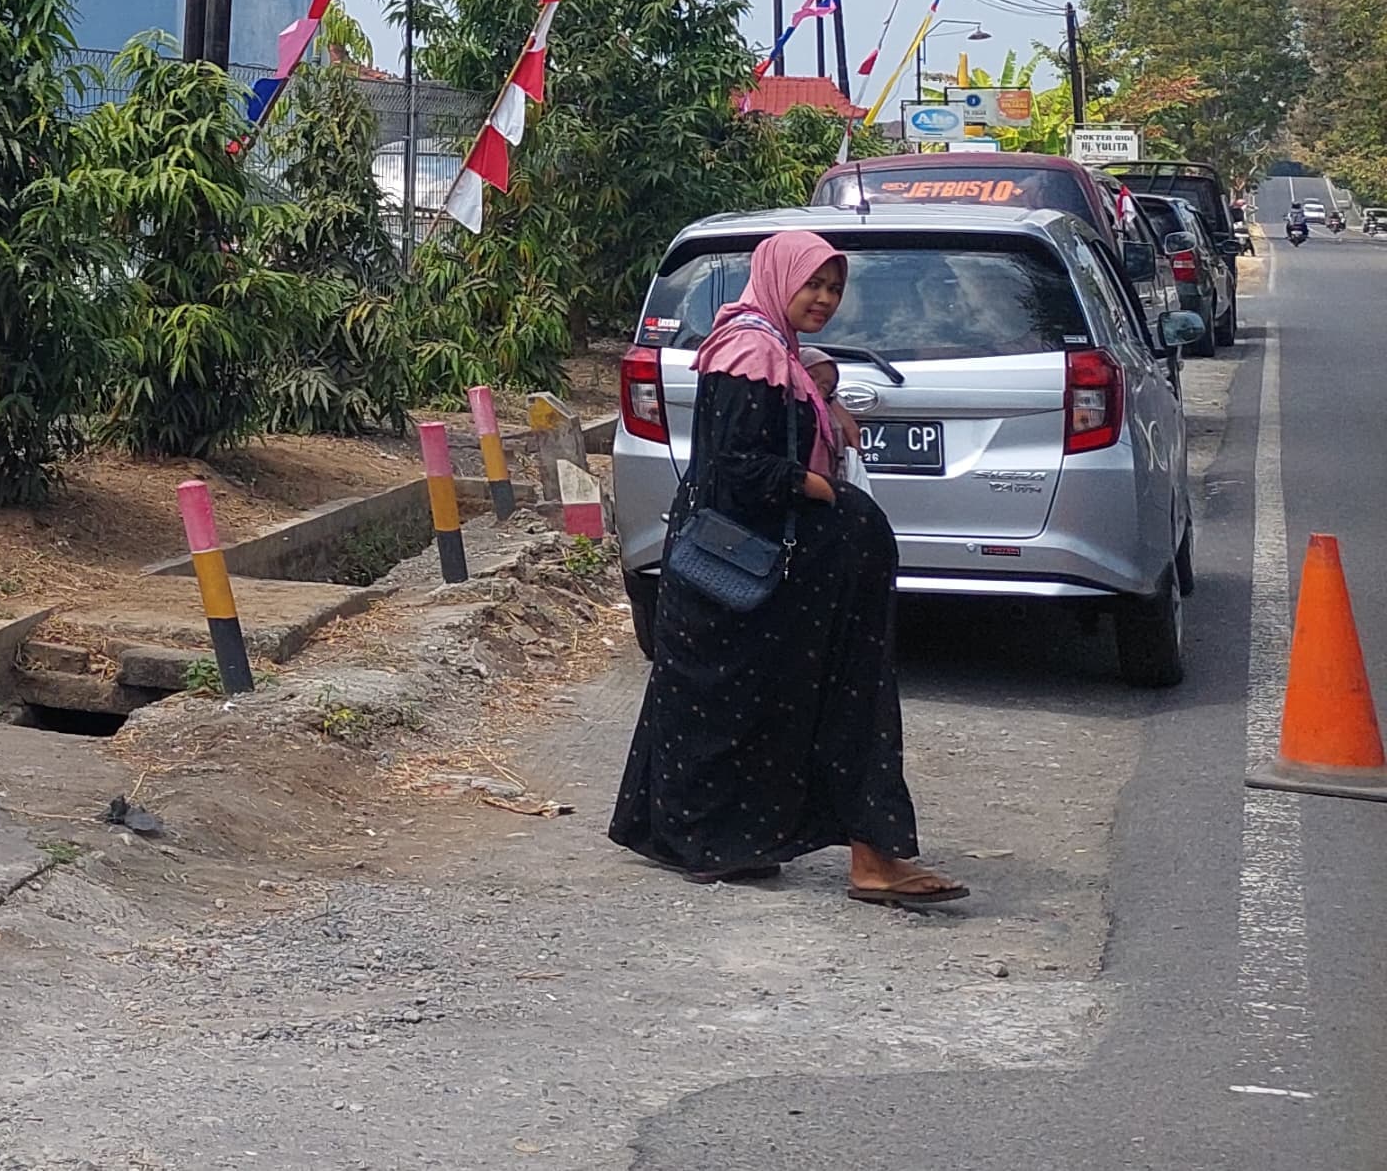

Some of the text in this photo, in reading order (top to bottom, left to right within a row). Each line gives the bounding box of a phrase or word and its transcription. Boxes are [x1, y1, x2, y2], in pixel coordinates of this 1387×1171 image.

[1095, 142, 1129, 153] YULITA
[903, 180, 982, 198] JETBUS
[908, 426, 937, 452] CP
